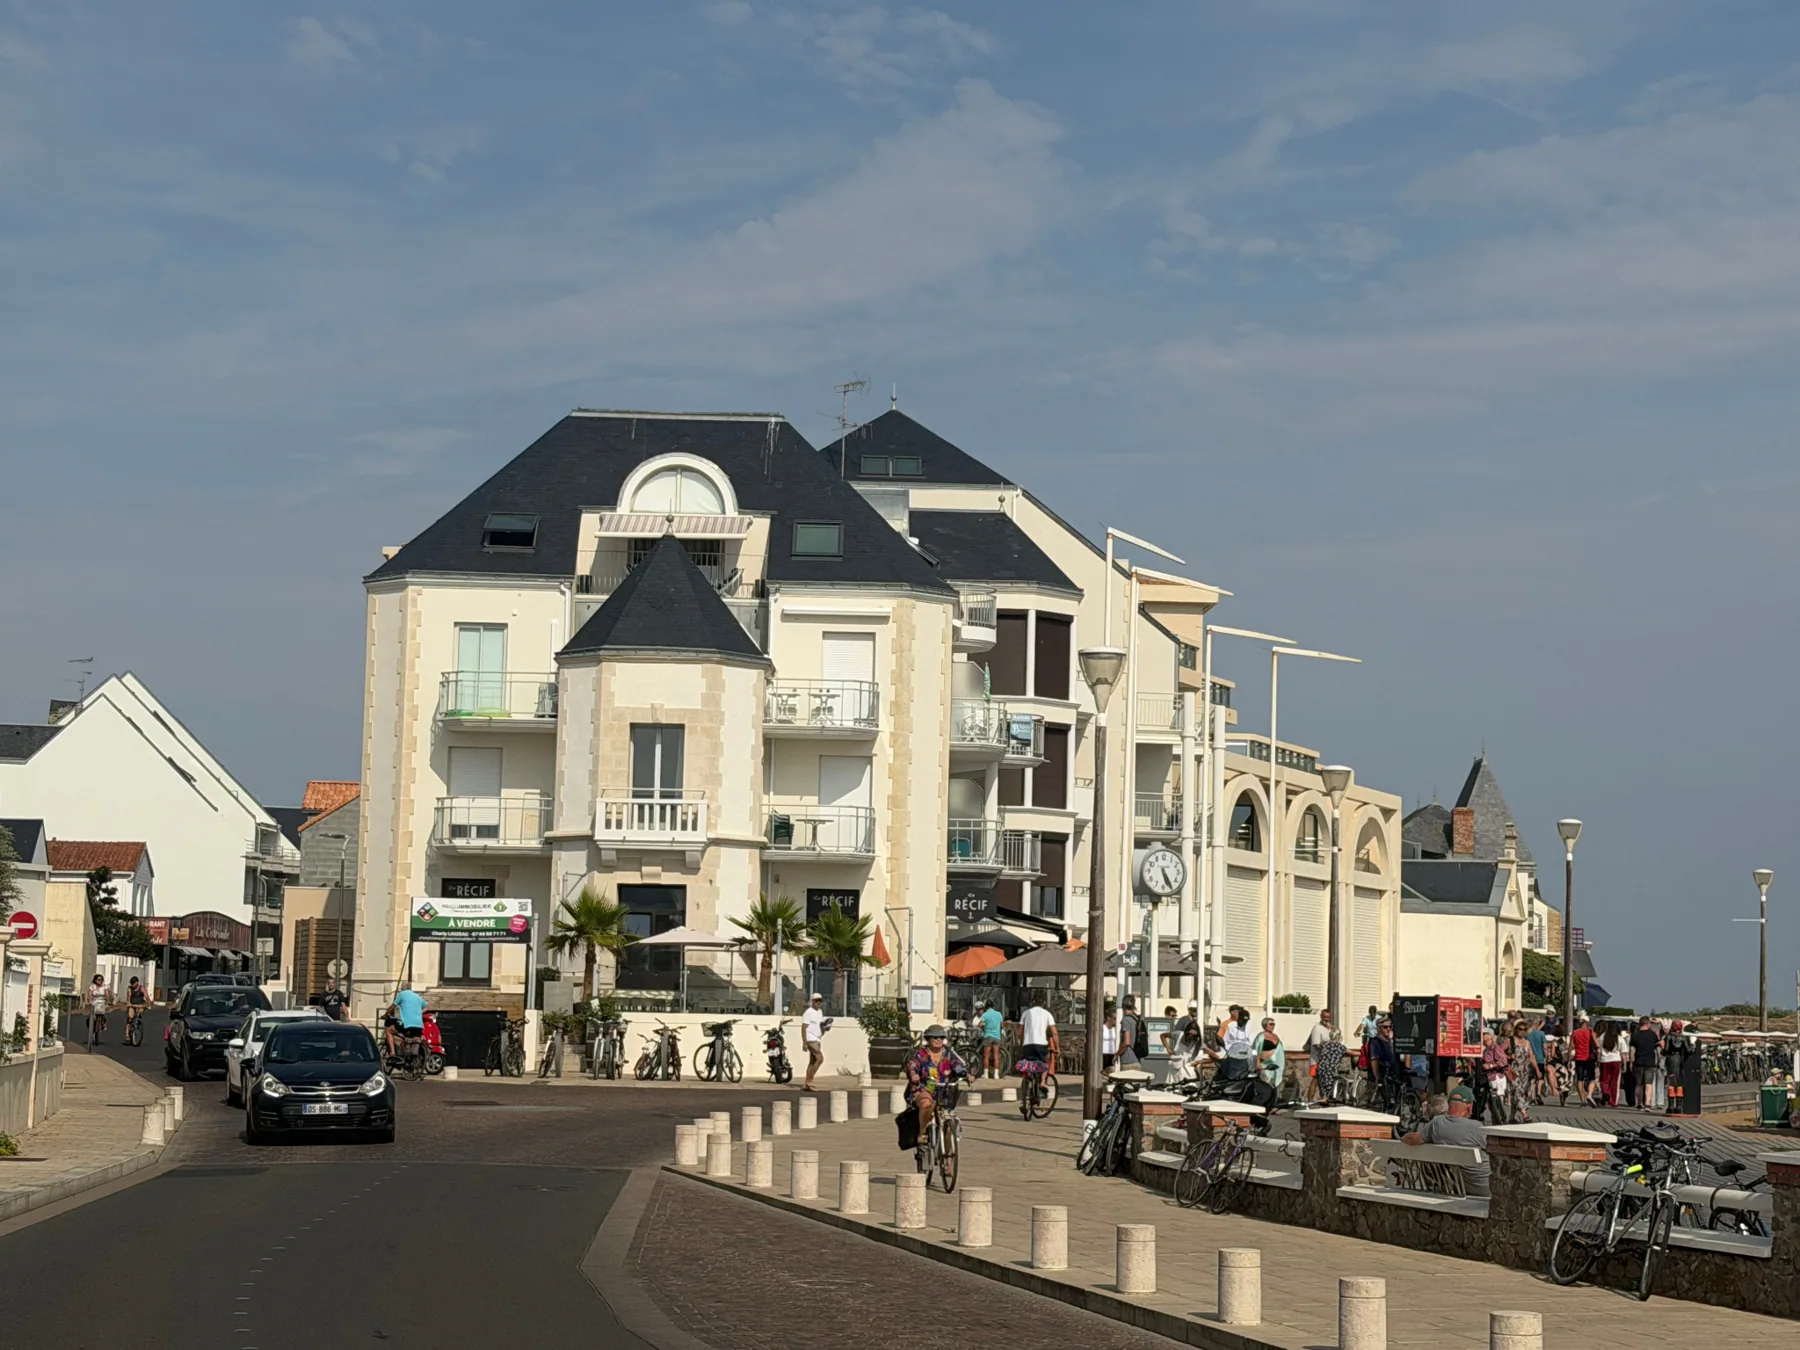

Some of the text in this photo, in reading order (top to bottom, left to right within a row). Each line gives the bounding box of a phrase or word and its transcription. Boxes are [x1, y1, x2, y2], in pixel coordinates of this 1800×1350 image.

[456, 883, 490, 897] RÉCIF
[954, 897, 988, 911] RÉCIF
[448, 917, 496, 928] À VENDRE
